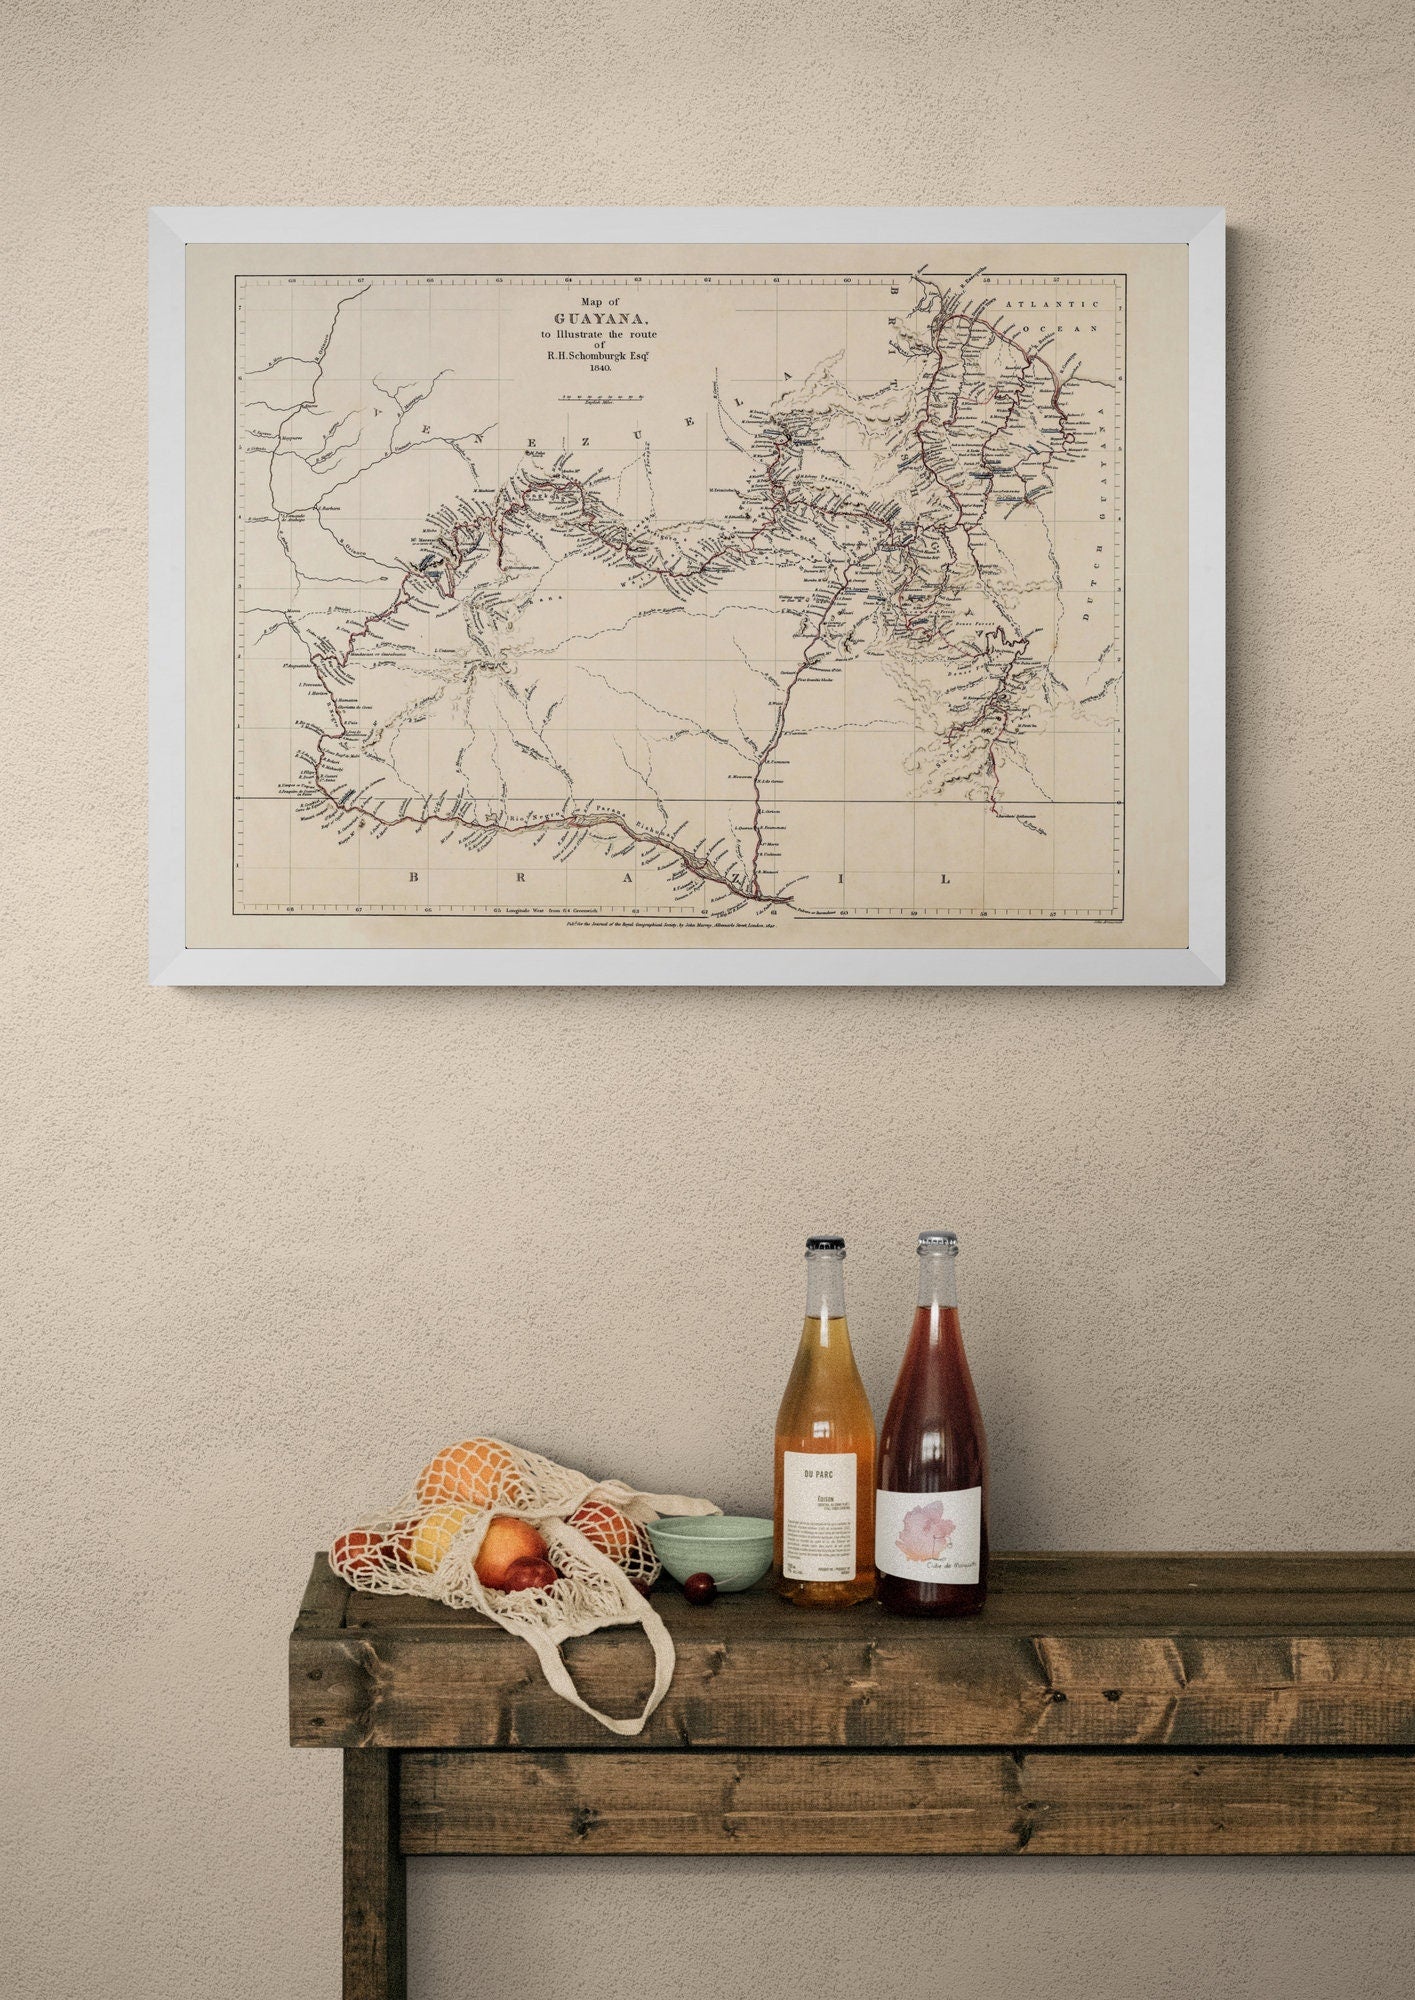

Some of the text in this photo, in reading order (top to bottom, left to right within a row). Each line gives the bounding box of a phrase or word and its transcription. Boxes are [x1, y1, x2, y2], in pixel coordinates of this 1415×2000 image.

[582, 298, 602, 307] Map
[554, 313, 649, 325] GUAYANA.
[557, 330, 602, 338] Illustrate
[609, 330, 623, 338] the
[804, 1470, 833, 1478] DU PARC
